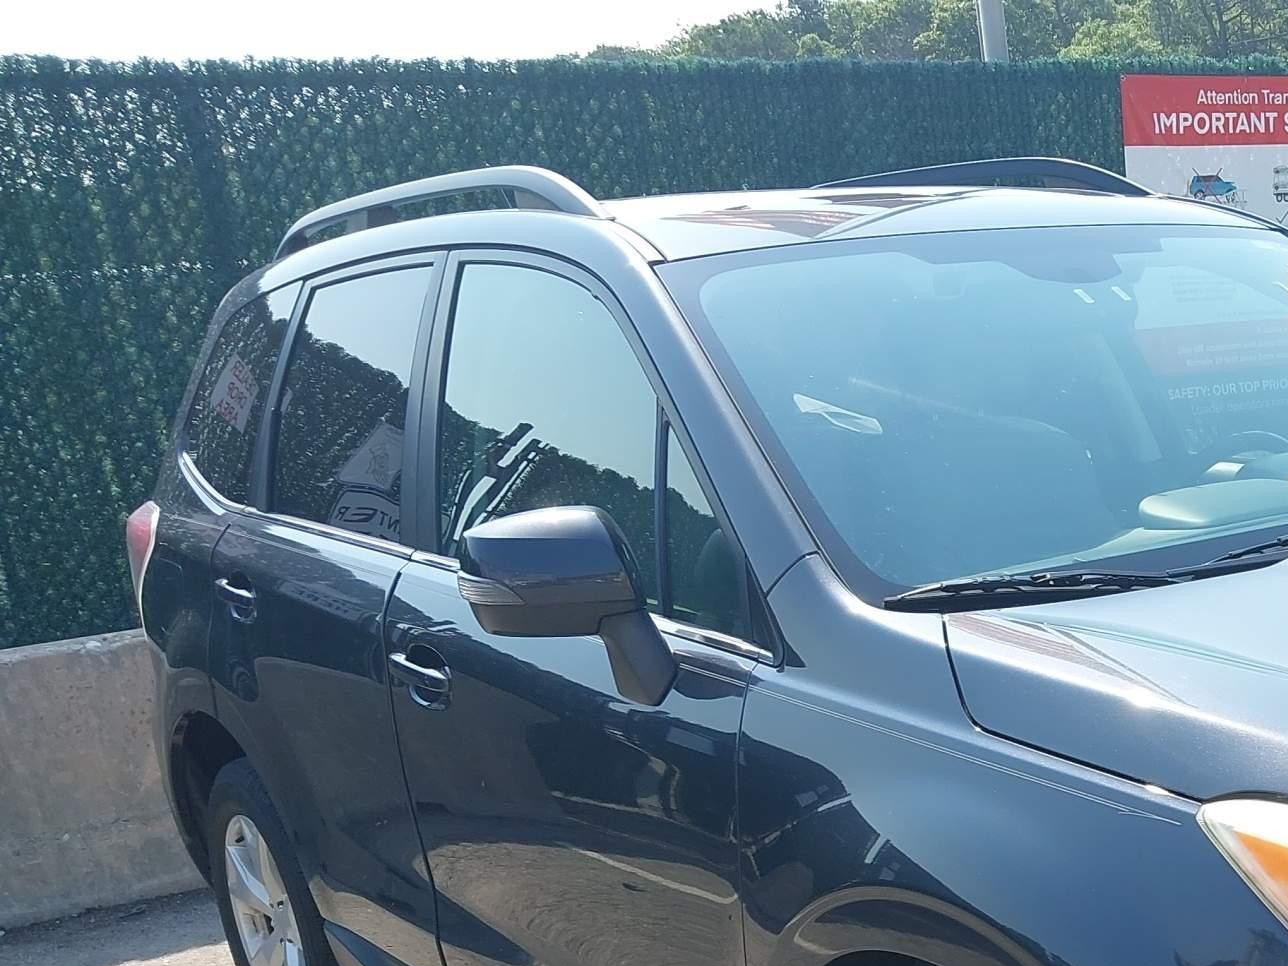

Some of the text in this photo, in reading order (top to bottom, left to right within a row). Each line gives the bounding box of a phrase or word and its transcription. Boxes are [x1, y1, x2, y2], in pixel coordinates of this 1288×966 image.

[1197, 88, 1258, 105] Attention
[1153, 111, 1278, 135] IMPORTANT
[1167, 384, 1211, 401] SAFETY:
[1212, 382, 1237, 396] OUR
[1238, 380, 1260, 394] TOP
